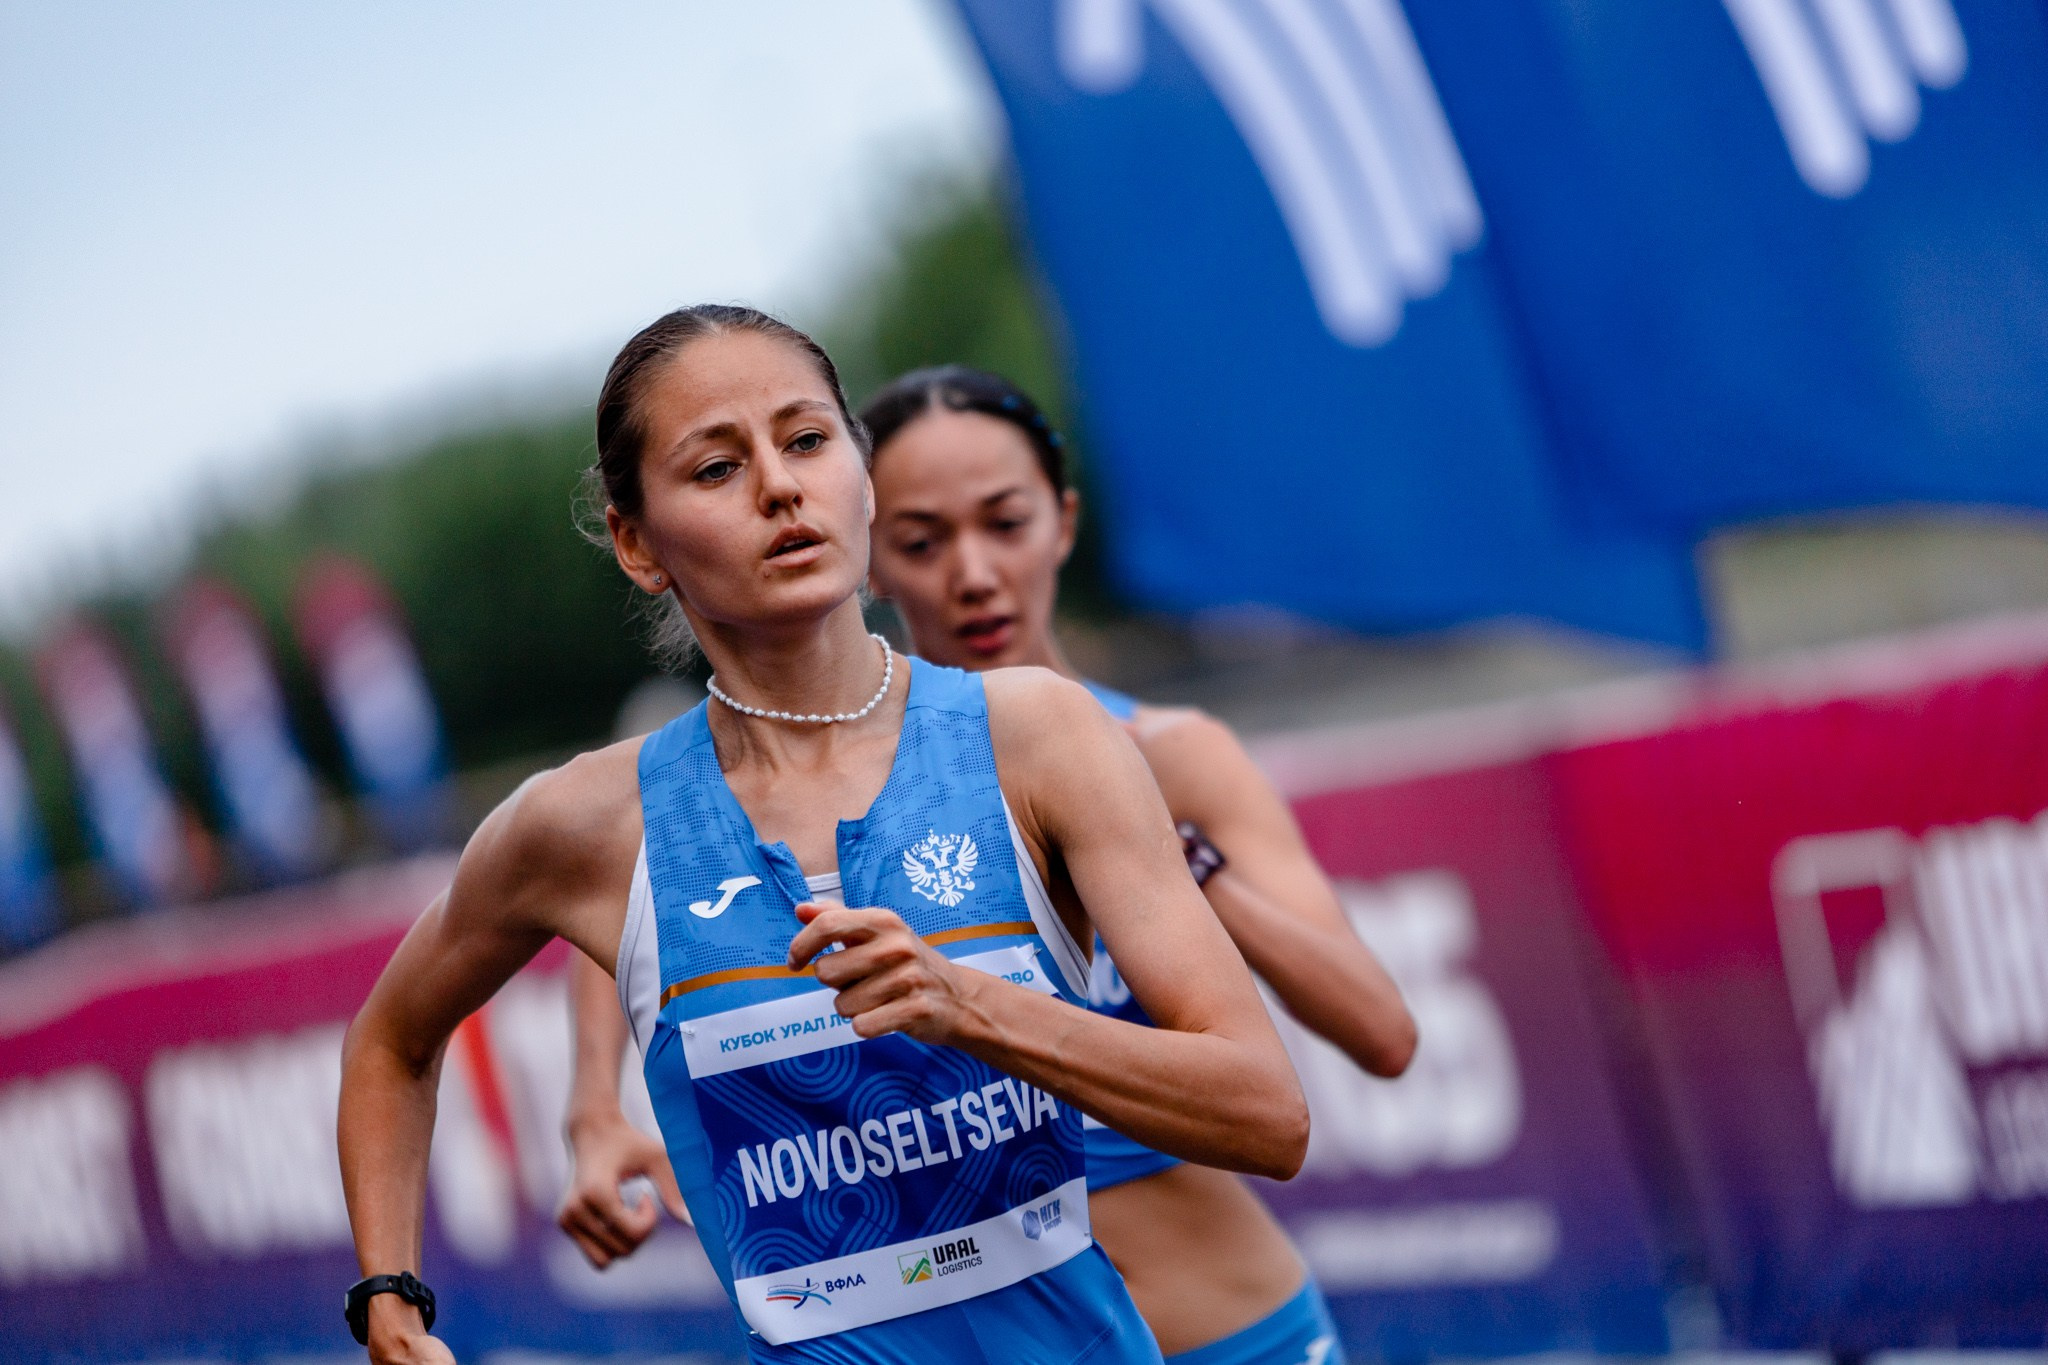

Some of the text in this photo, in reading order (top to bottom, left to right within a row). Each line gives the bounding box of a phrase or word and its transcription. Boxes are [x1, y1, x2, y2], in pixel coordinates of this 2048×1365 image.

[719, 1028, 777, 1053] КУБОК
[780, 1016, 826, 1039] УРАЛ
[737, 1077, 1060, 1208] NOVOSELTSEVA
[932, 1237, 980, 1265] URAL
[936, 1256, 983, 1277] LOGISTICS
[825, 1273, 866, 1293] ВФЛА
